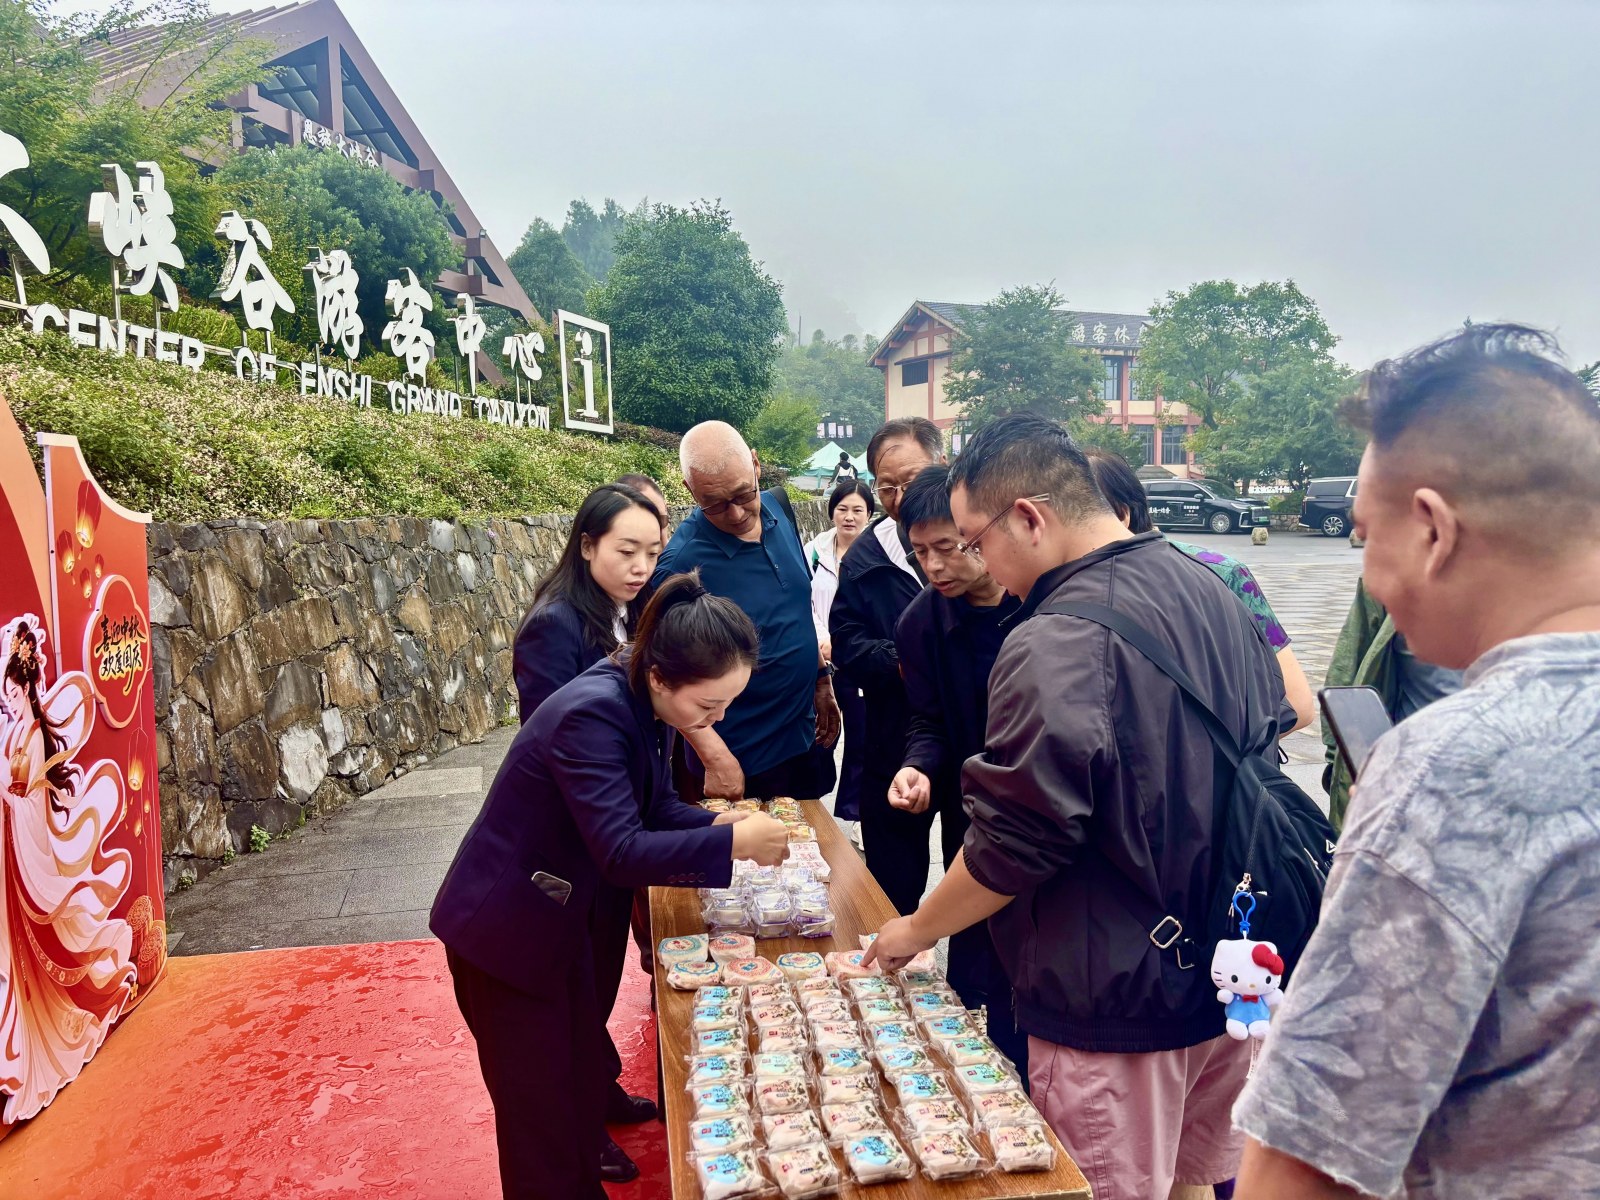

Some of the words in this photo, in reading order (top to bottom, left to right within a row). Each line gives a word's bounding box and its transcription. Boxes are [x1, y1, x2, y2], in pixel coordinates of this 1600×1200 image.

[32, 302, 206, 372] CENTER
[234, 346, 277, 383] OF
[300, 360, 372, 409] ENSHI
[387, 380, 462, 419] GRAND
[476, 396, 550, 430] CANYON
[95, 614, 147, 655] 喜迎中秋
[101, 640, 142, 692] 欢度国庆
